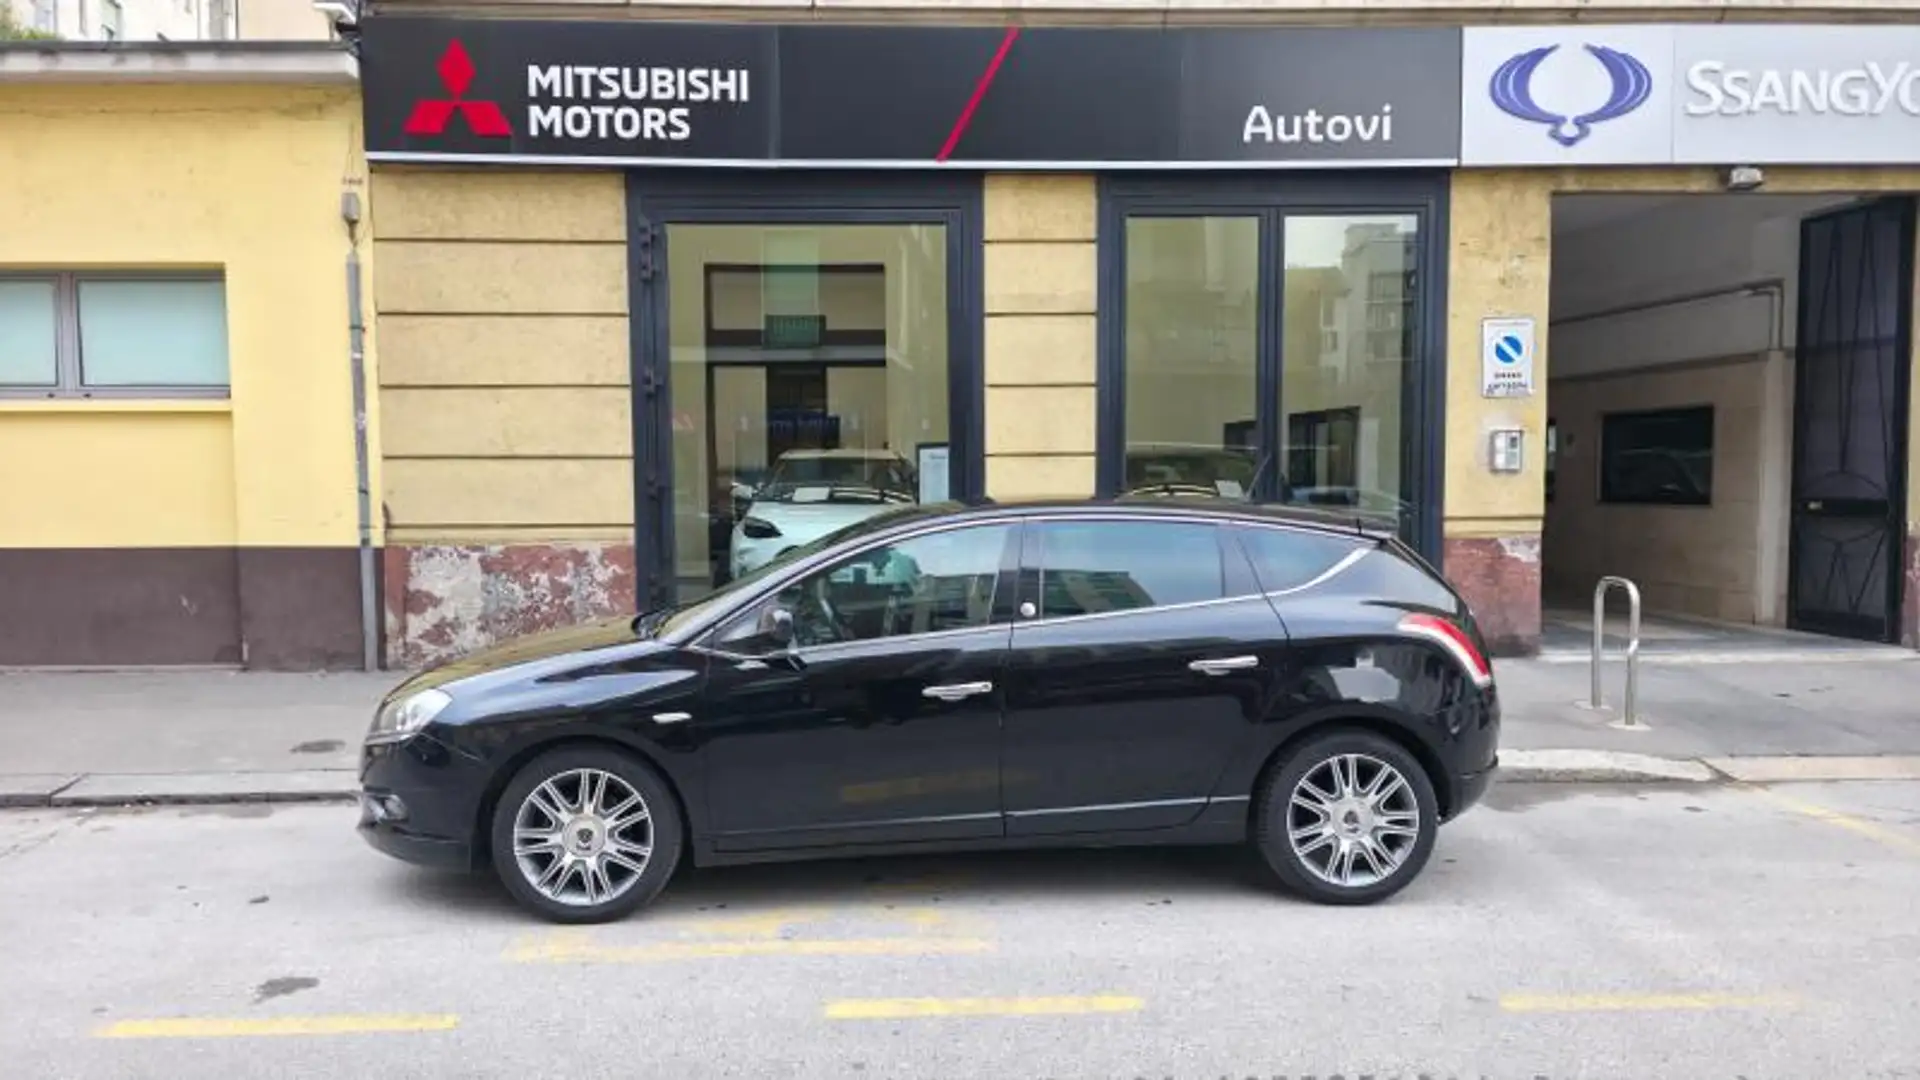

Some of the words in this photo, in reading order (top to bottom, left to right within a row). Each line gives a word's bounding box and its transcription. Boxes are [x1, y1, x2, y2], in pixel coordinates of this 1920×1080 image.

[527, 65, 748, 102] MITSUBISHI
[529, 106, 690, 140] MOTORS
[1243, 105, 1393, 143] Autovi
